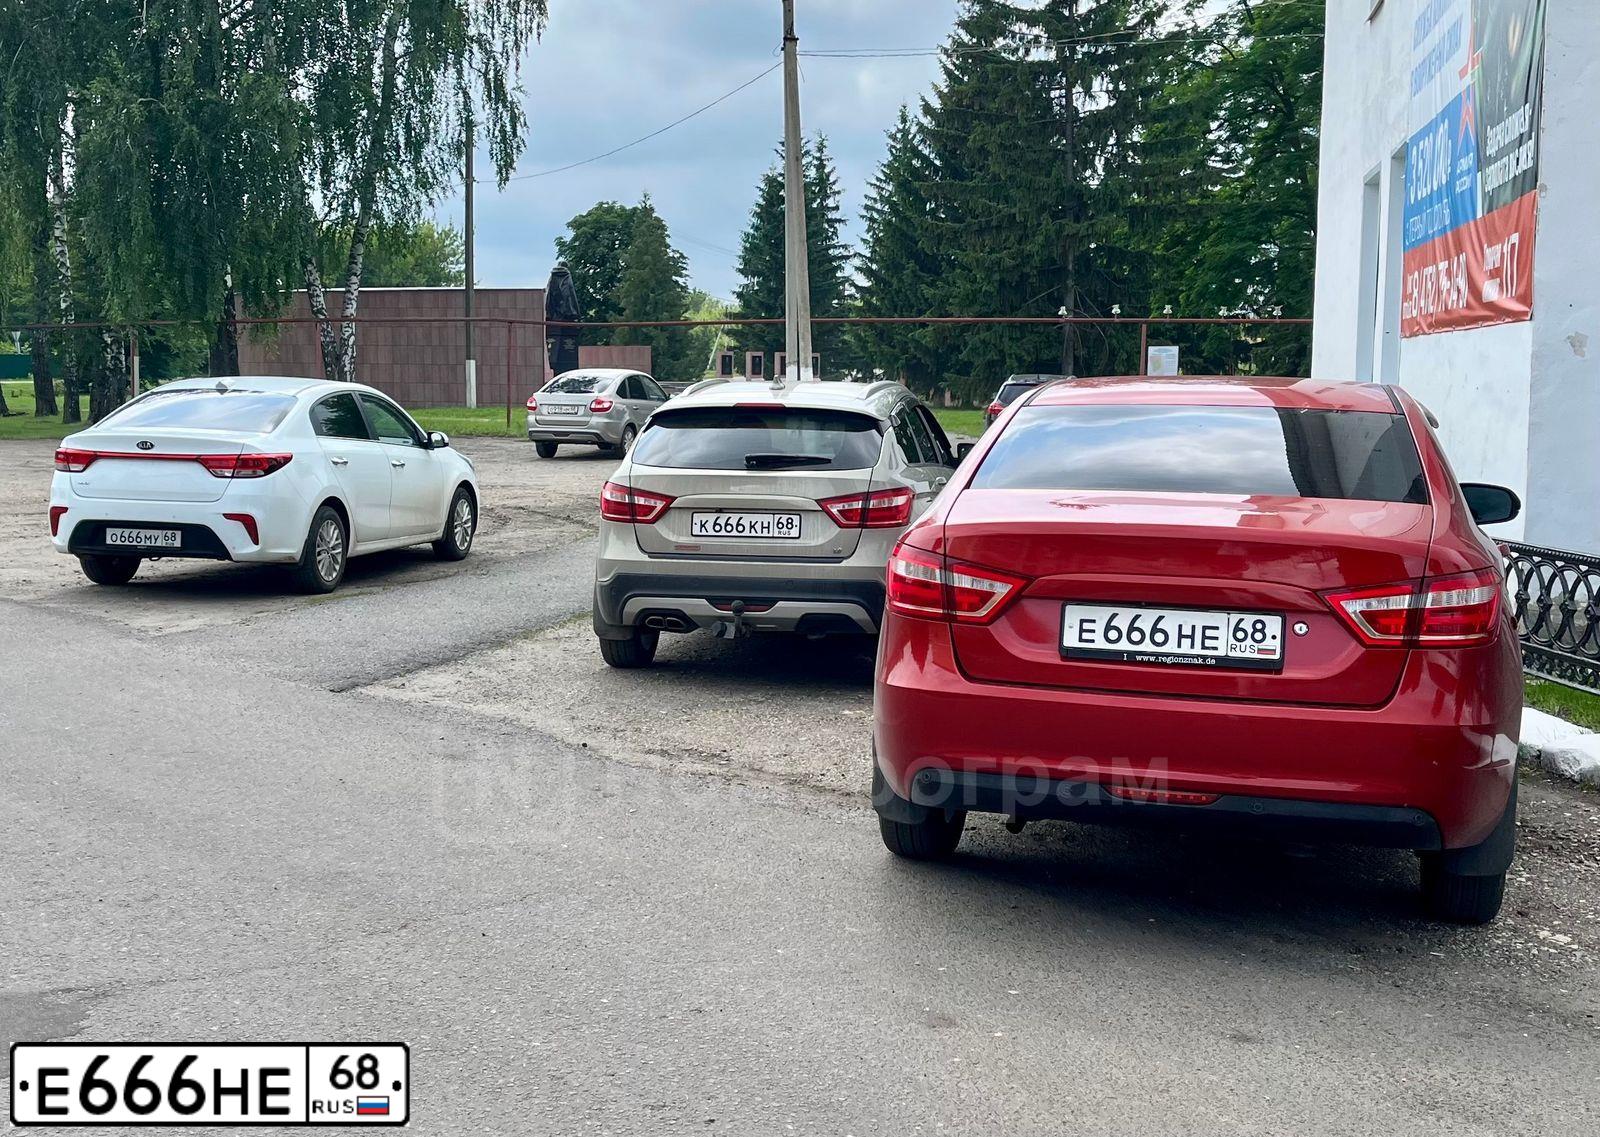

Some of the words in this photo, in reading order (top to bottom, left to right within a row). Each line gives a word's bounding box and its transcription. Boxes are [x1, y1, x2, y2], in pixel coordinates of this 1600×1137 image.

[699, 516, 771, 535] К666КН
[776, 516, 794, 530] 68
[110, 530, 160, 545] О666МУ
[163, 531, 177, 542] 68
[1077, 612, 1220, 651] Е666НЕ
[1232, 617, 1267, 644] 68
[1230, 643, 1256, 655] RUS
[1135, 653, 1216, 666] www.regionznak.de
